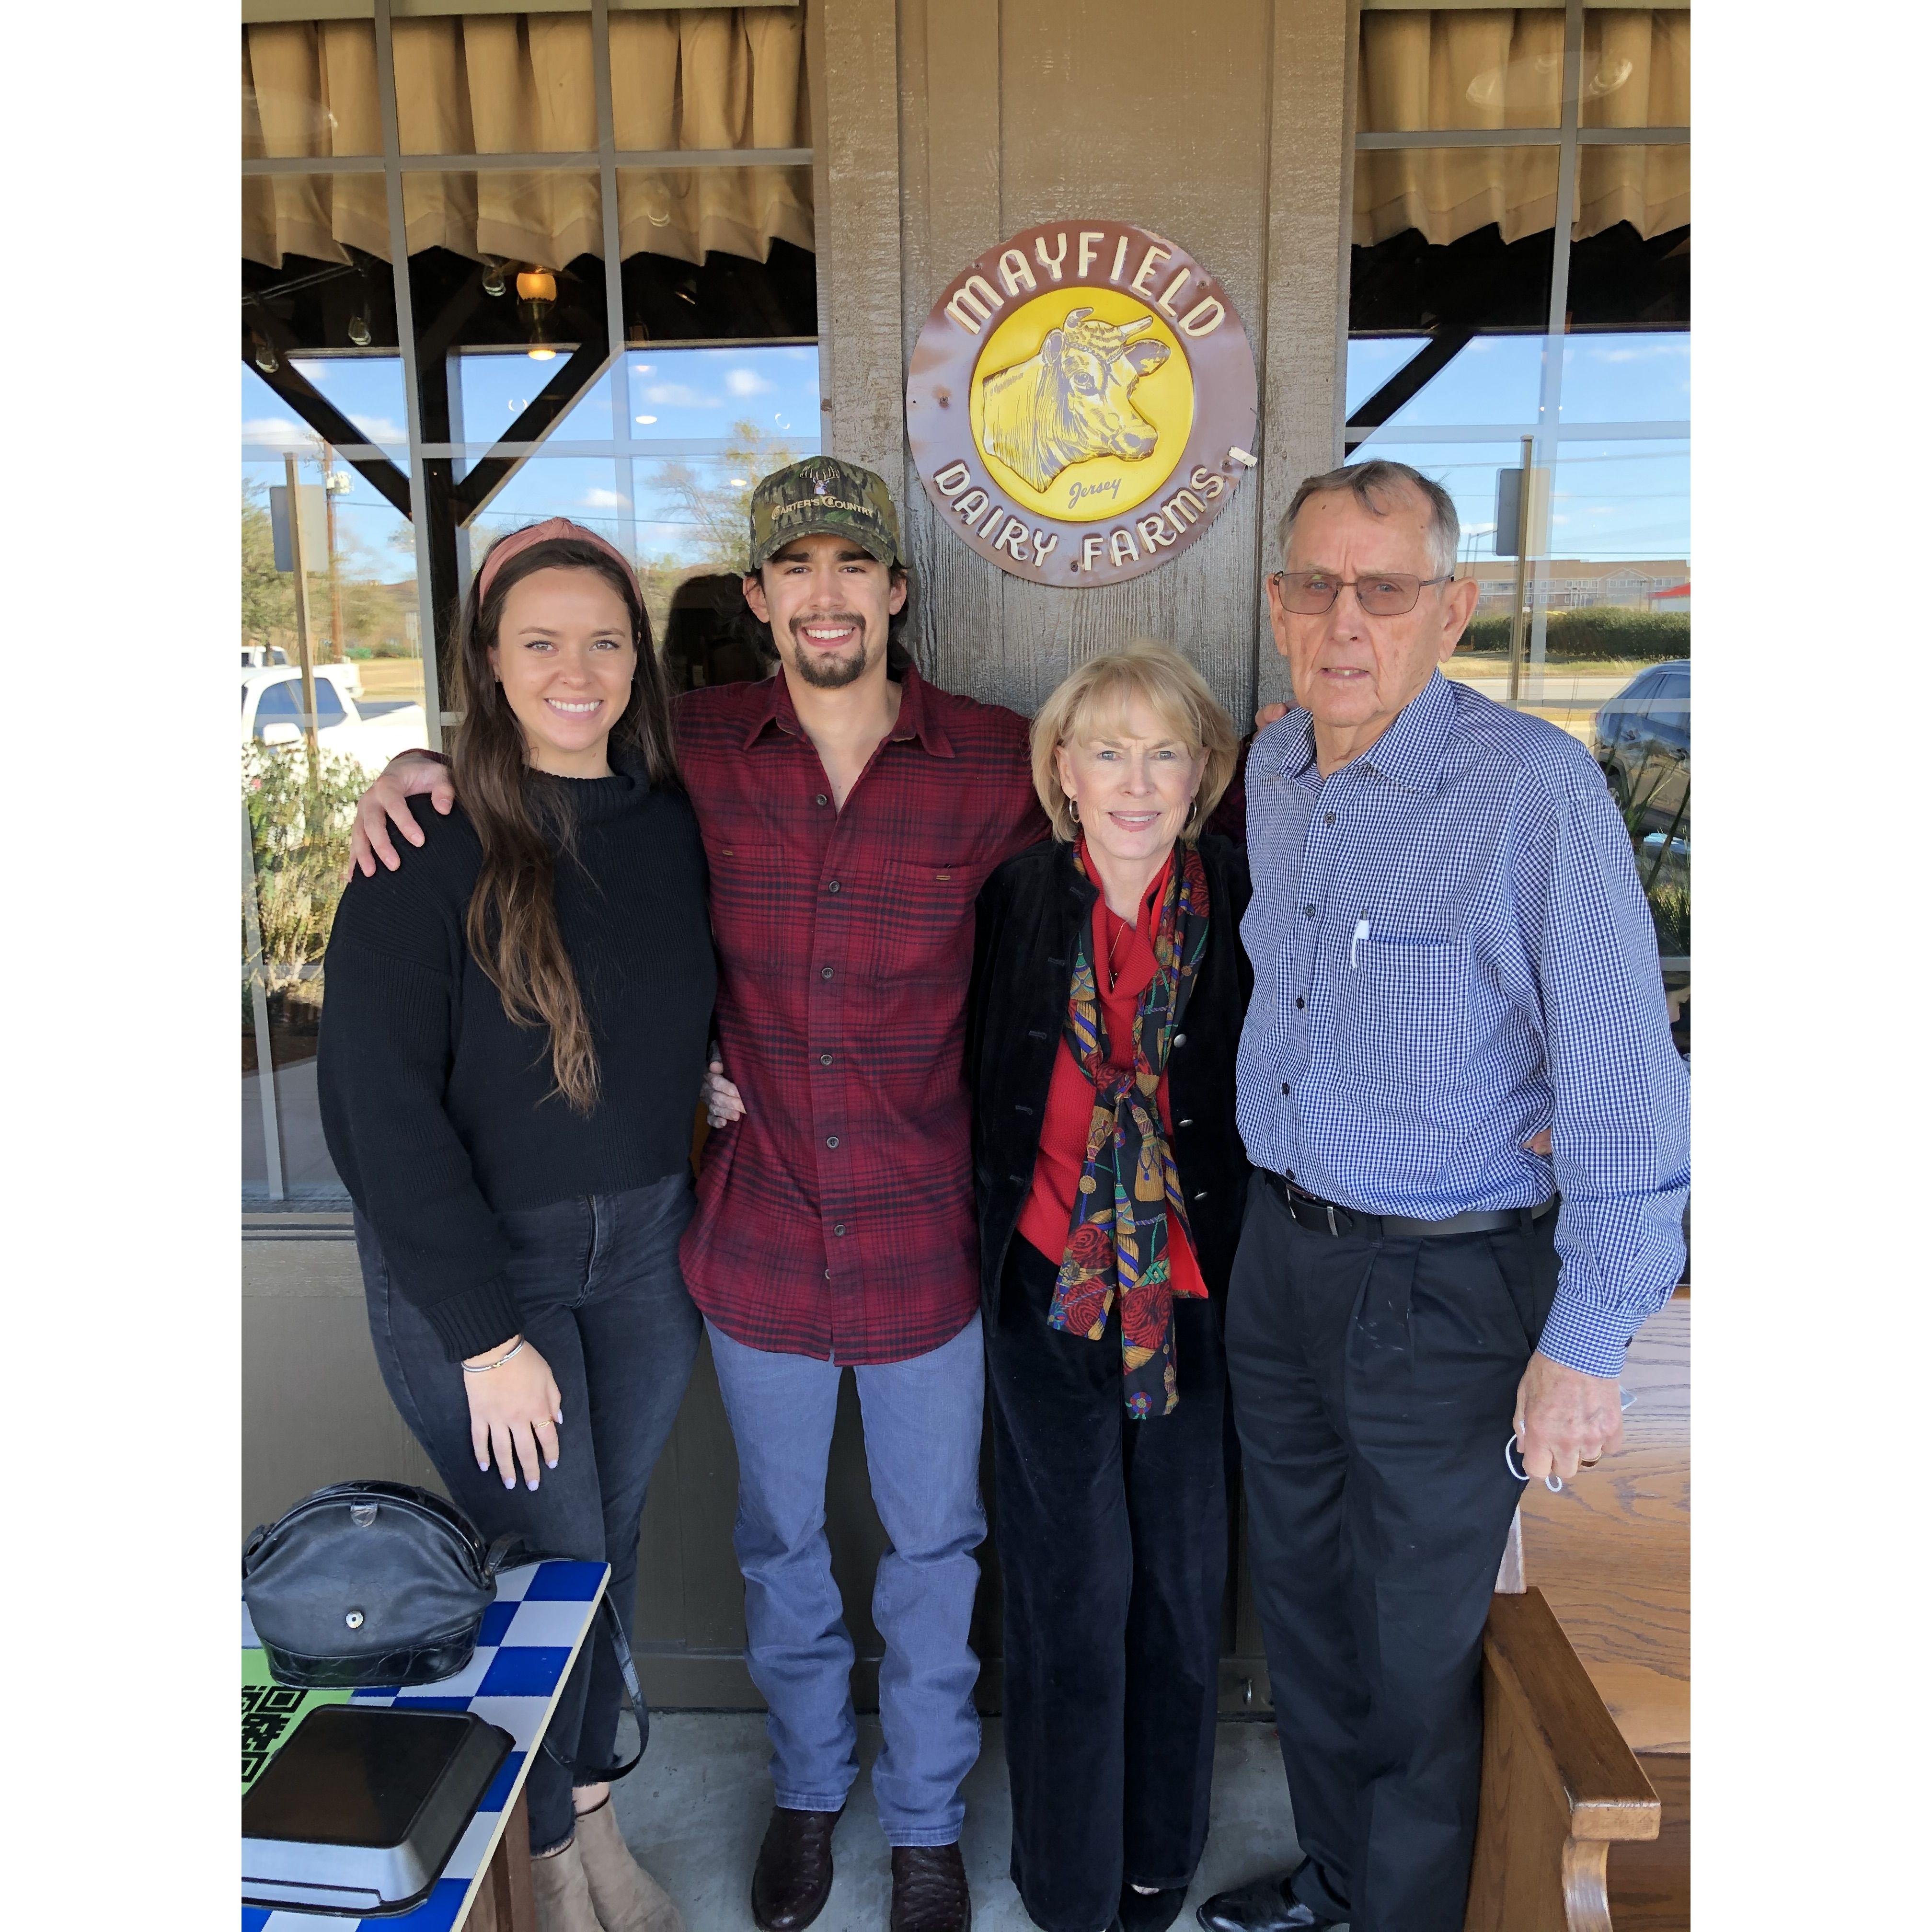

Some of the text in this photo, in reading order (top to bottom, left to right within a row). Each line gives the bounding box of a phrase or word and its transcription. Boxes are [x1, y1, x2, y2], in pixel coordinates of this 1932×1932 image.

[946, 231, 1226, 337] MAYFIELD
[771, 495, 874, 520] CARTER'S COUNTRY
[934, 463, 1225, 571] DAIRY FARMS
[1069, 476, 1122, 509] Jersey
